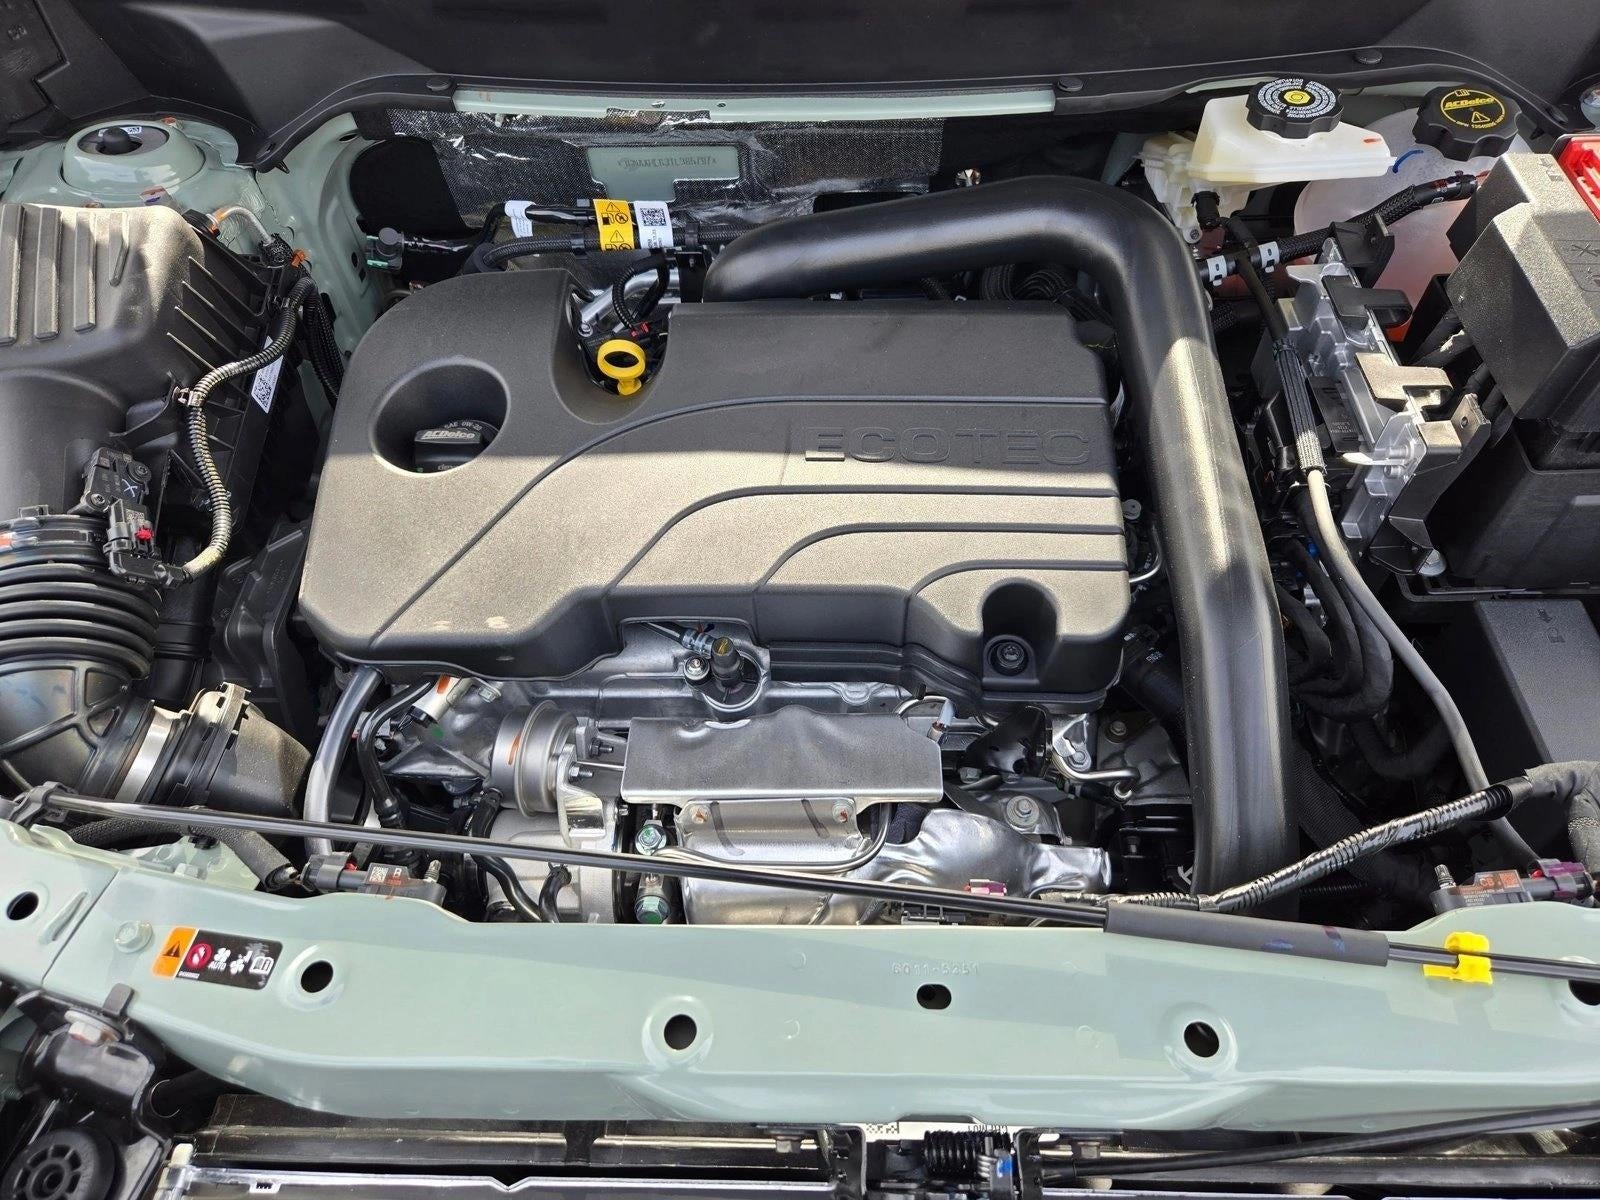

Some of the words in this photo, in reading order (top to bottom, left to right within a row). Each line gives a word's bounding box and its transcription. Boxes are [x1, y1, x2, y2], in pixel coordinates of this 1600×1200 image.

[1444, 98, 1495, 110] ACDelco
[421, 430, 475, 440] ACDelco
[804, 427, 1089, 465] ECOTEC
